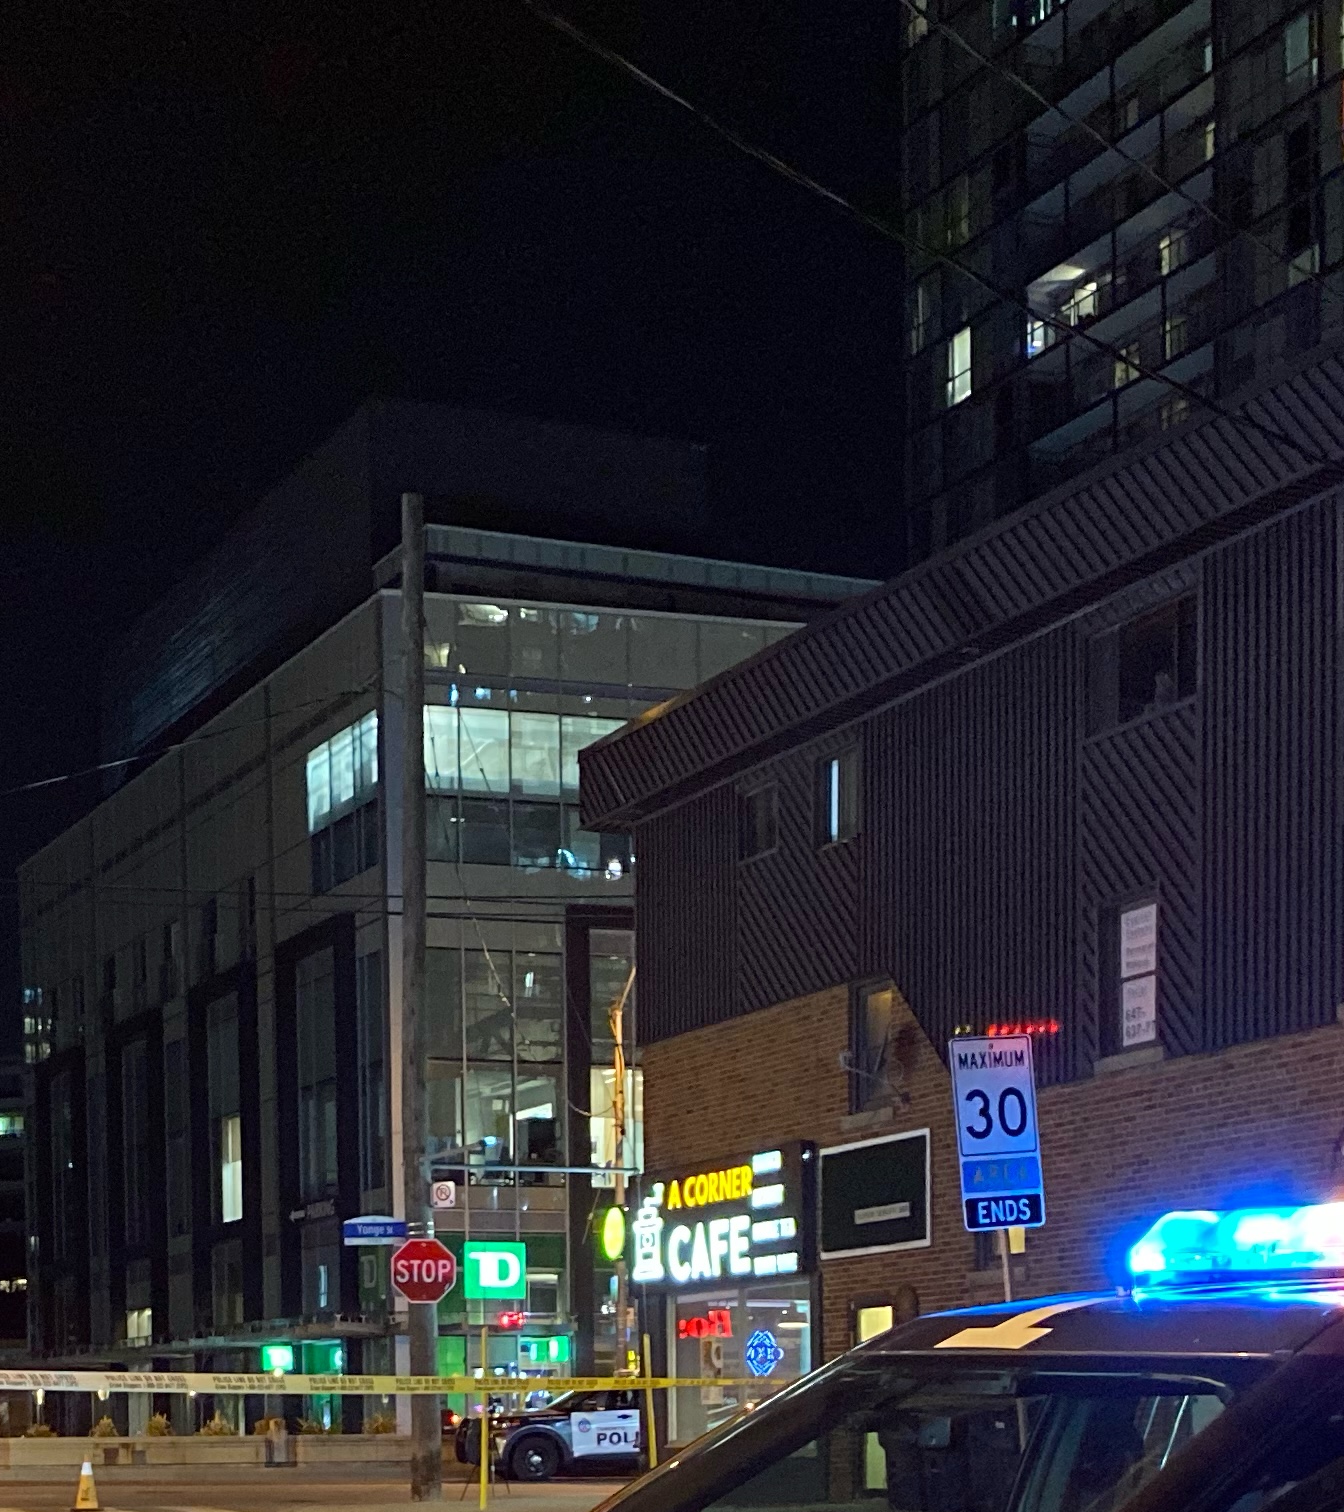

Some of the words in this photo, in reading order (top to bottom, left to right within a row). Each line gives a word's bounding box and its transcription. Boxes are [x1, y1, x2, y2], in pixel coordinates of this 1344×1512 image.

[958, 1050, 1025, 1070] MAXIMUM
[965, 1087, 1027, 1139] 30
[667, 1180, 682, 1210] A
[683, 1165, 753, 1207] CORNER
[978, 1199, 1031, 1225] ENDS
[357, 1224, 385, 1237] Yonge
[668, 1215, 752, 1283] CAFE
[396, 1259, 452, 1283] STOP
[469, 1251, 521, 1288] TD
